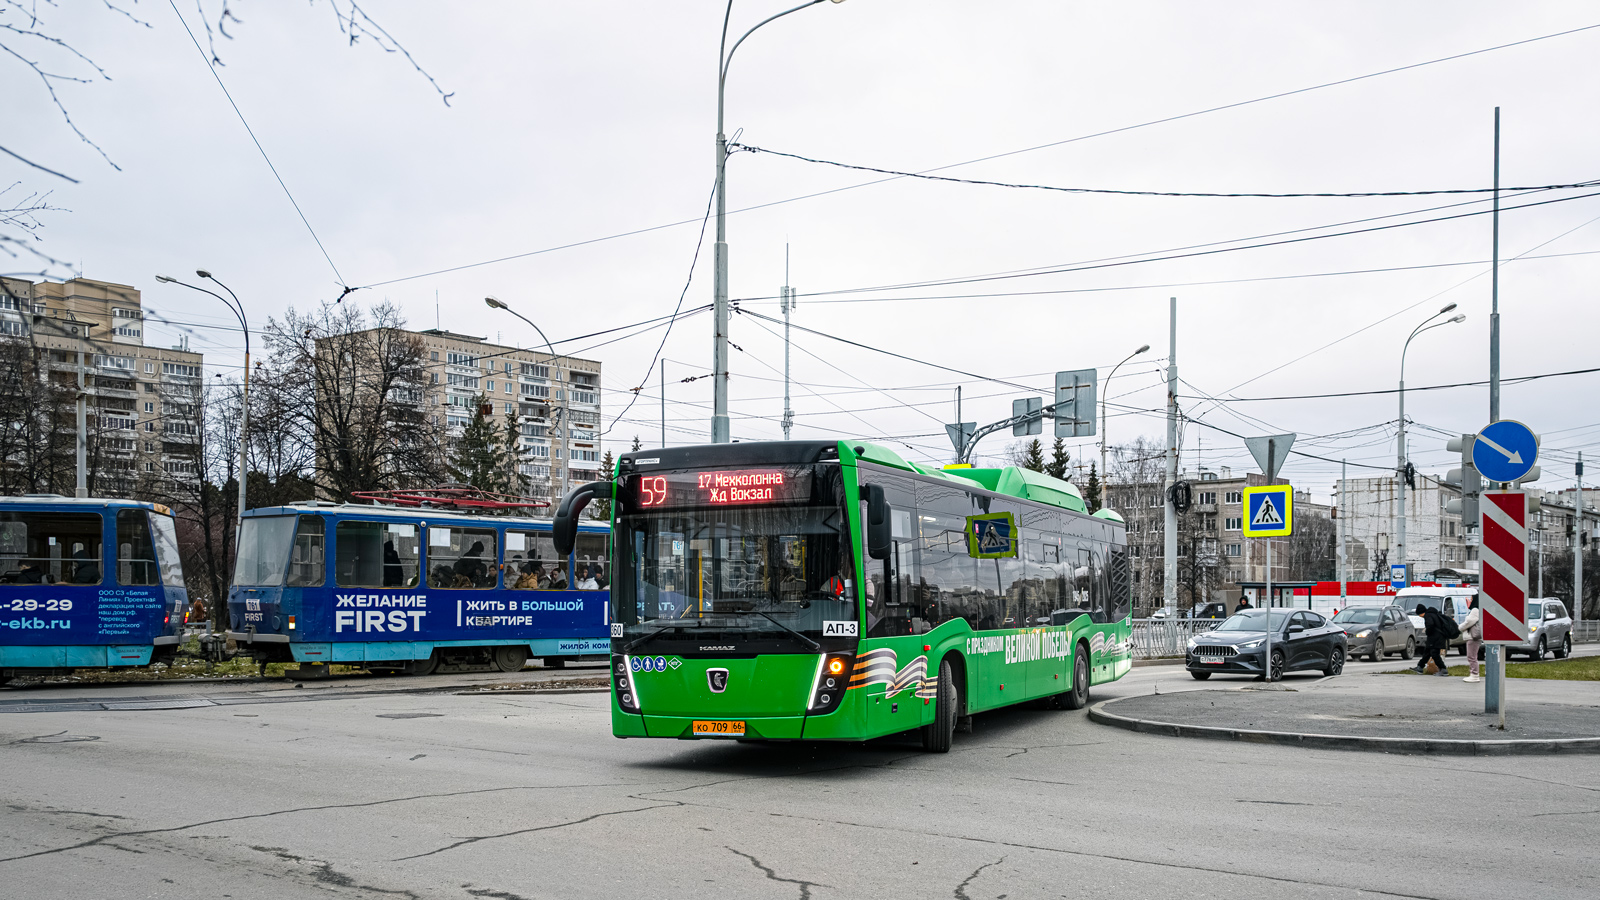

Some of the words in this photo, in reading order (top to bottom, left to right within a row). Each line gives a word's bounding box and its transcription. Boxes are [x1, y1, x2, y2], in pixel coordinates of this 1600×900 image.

[699, 475, 711, 488] 17
[716, 473, 783, 487] Мехколонна
[641, 477, 667, 505] 59
[710, 488, 727, 502] Жд
[731, 487, 772, 500] Вокзал
[0, 599, 73, 611] -29-29
[336, 594, 427, 607] ЖЕЛАНИЕ
[466, 601, 505, 611] ЖИТЬ
[509, 601, 517, 611] В
[522, 599, 584, 611] БОЛЬШОЙ
[0, 616, 71, 629] -ekb.ru
[244, 613, 263, 621] FIRST
[336, 610, 427, 632] FIRST
[466, 616, 533, 626] КВАРТИРЕ
[826, 623, 856, 634] АП-3
[560, 641, 589, 650] жилой
[966, 638, 971, 655] С
[971, 635, 1004, 656] ПРАЗДНИКОМ
[1005, 631, 1040, 665] ВЕЛИКОЙ
[1042, 630, 1073, 662] ПОБЕДЫ
[711, 722, 728, 732] 709
[733, 722, 742, 730] 66
